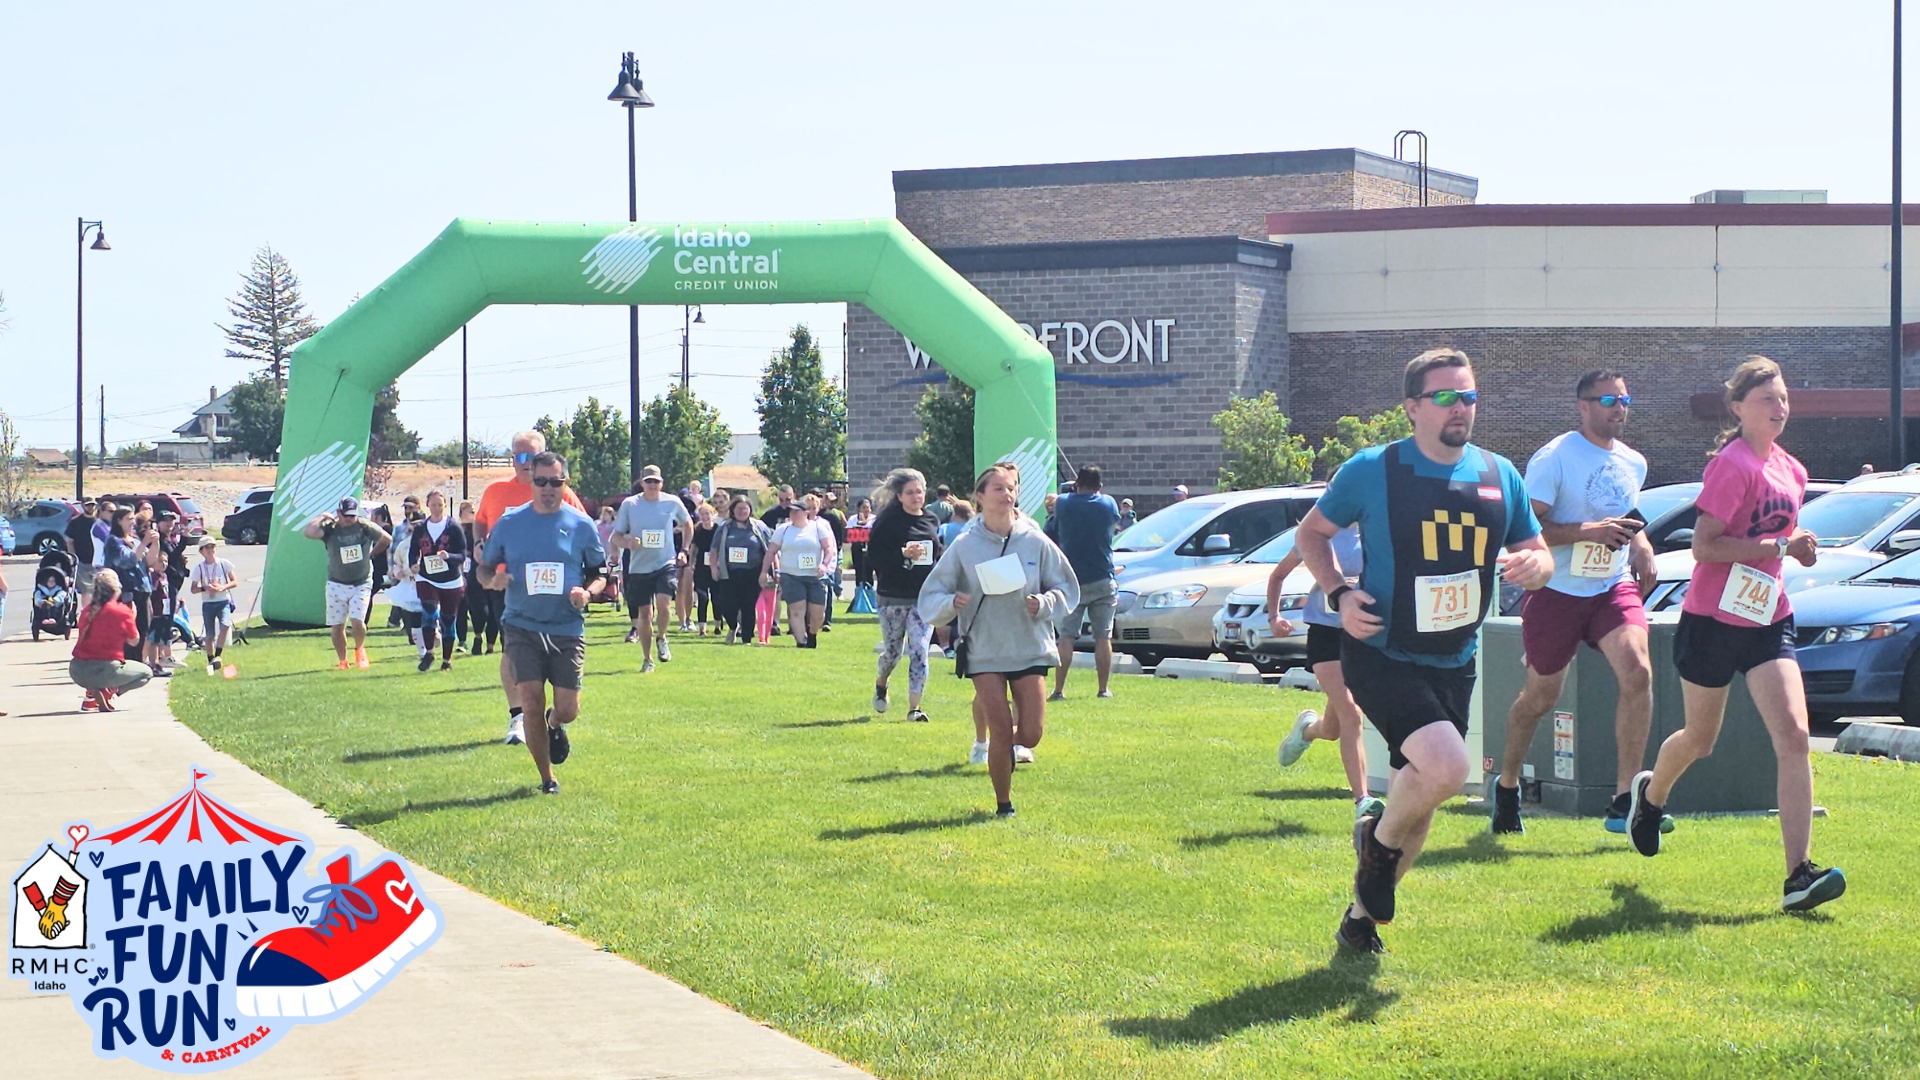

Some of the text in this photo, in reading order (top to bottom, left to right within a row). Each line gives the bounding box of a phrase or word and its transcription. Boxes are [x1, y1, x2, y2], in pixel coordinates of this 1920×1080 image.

[674, 228, 751, 248] Idaho
[673, 249, 779, 275] Central
[674, 280, 778, 290] CREDIT UNION
[903, 318, 1176, 370] WFRONT
[1584, 545, 1612, 565] 735
[533, 569, 557, 584] 745
[1430, 583, 1468, 613] 731
[1737, 575, 1771, 607] 744
